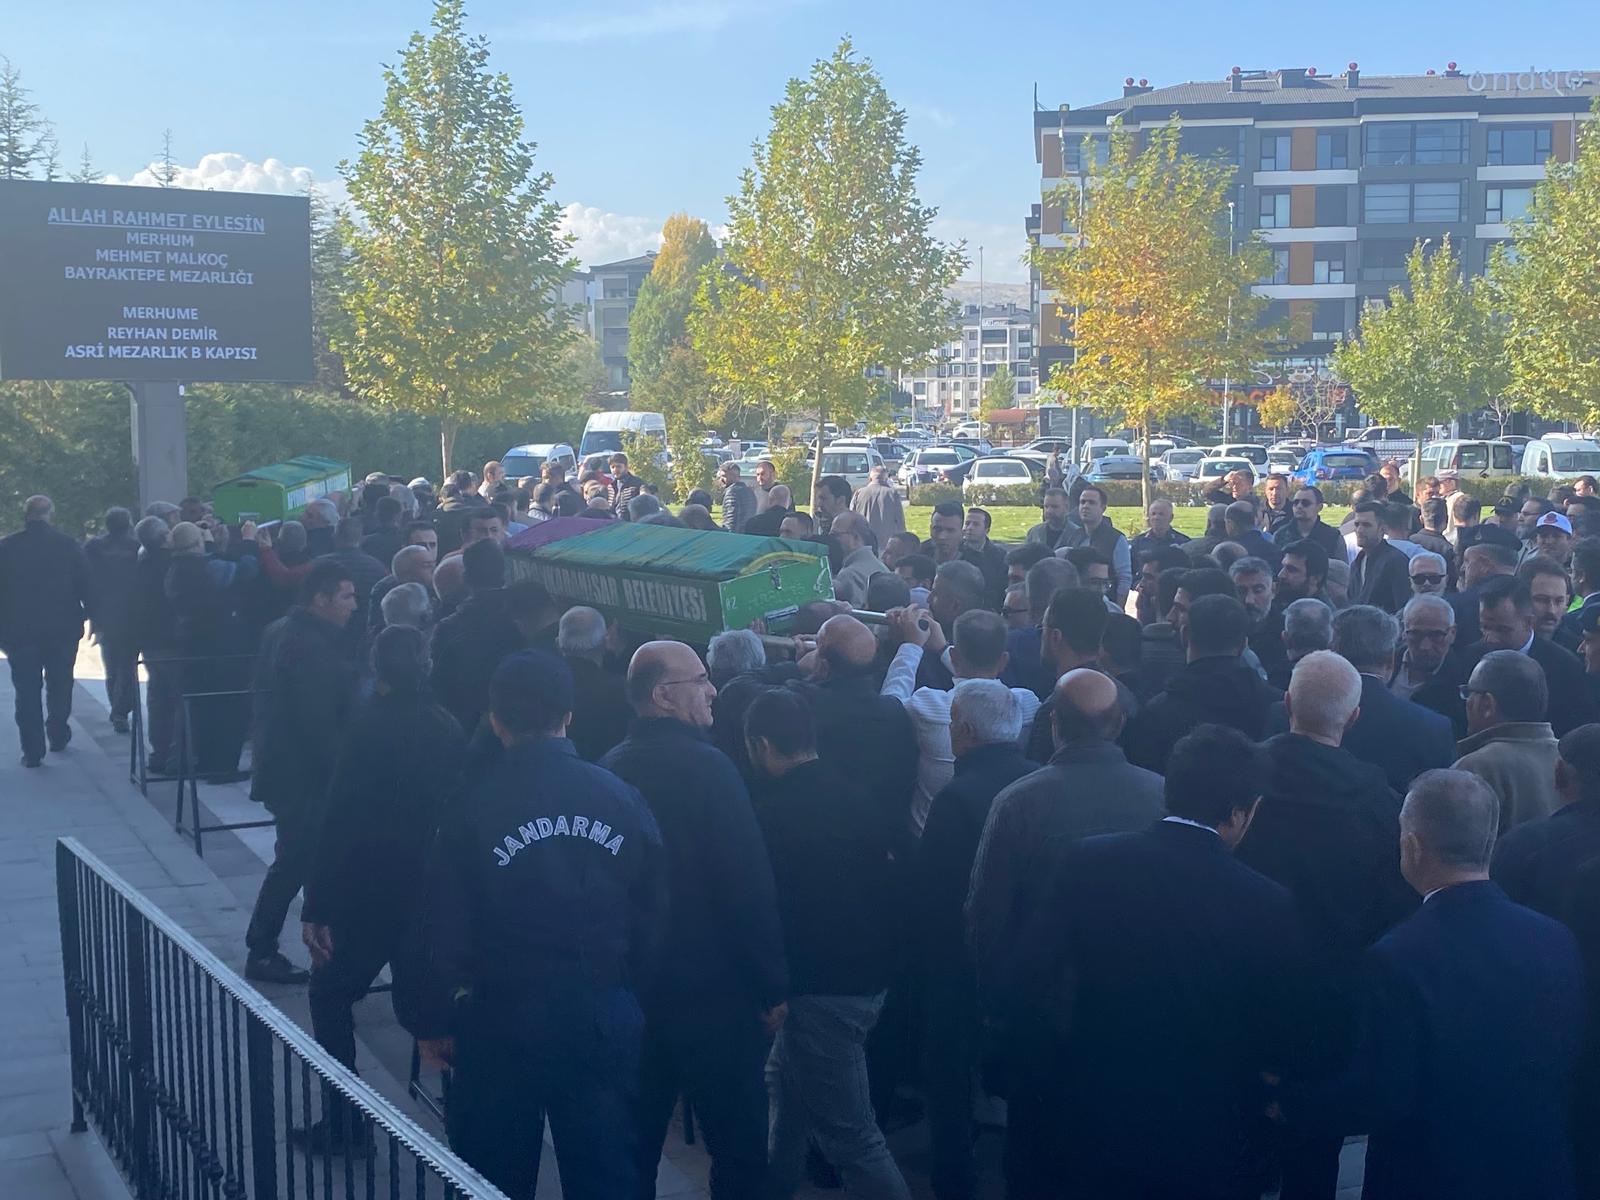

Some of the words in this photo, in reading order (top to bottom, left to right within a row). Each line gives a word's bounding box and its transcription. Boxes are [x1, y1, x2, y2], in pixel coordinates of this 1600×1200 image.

[48, 207, 107, 225] ALLAH
[113, 209, 187, 229] RAHMET
[193, 213, 265, 233] EYLESİN
[127, 232, 194, 247] MERHUM
[96, 249, 162, 264] MEHMET
[166, 252, 229, 268] MALKOÇ
[64, 266, 166, 282] BAYRAKTEPE
[170, 268, 254, 285] MEZARLIĞI
[123, 306, 199, 320] MERHUME
[107, 326, 168, 341] REYHAN
[172, 326, 218, 341] DEMİR
[65, 342, 104, 359] ASRİ
[108, 345, 188, 359] MEZARLIK
[191, 347, 201, 359] B
[205, 346, 258, 360] KAPISI
[493, 815, 625, 867] JANDARMA
